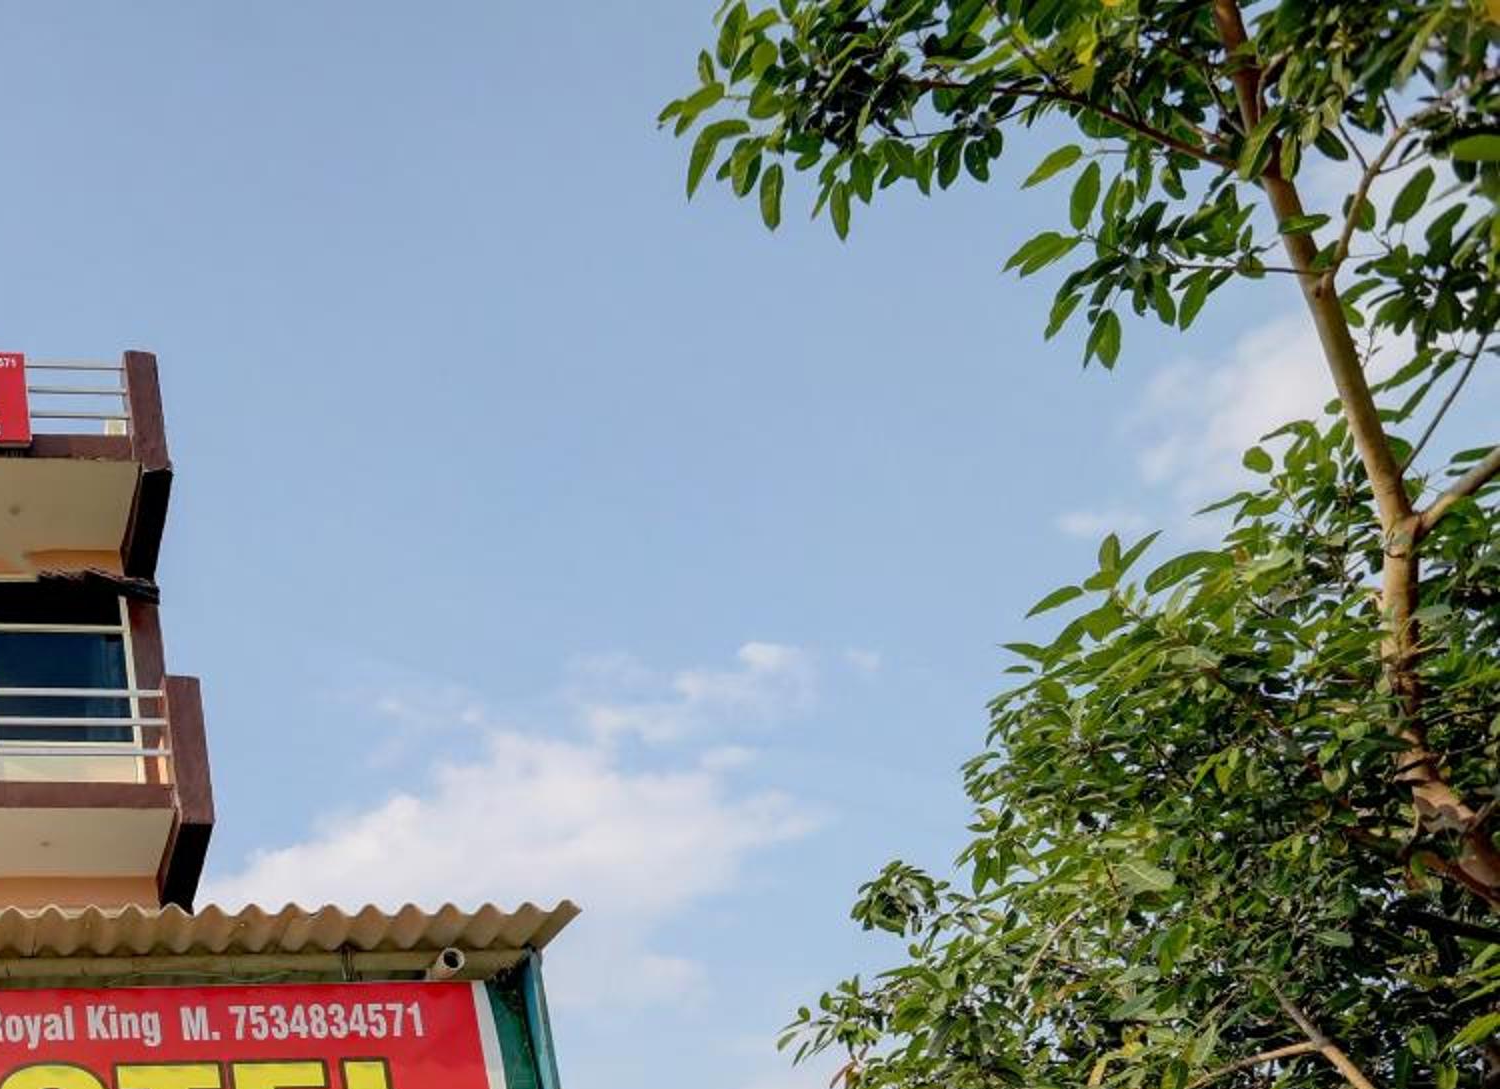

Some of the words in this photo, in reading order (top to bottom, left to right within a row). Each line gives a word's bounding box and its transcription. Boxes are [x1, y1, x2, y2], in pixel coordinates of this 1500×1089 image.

[86, 1004, 162, 1047] King
[180, 1006, 220, 1041] M.
[228, 1002, 425, 1038] 7534834571
